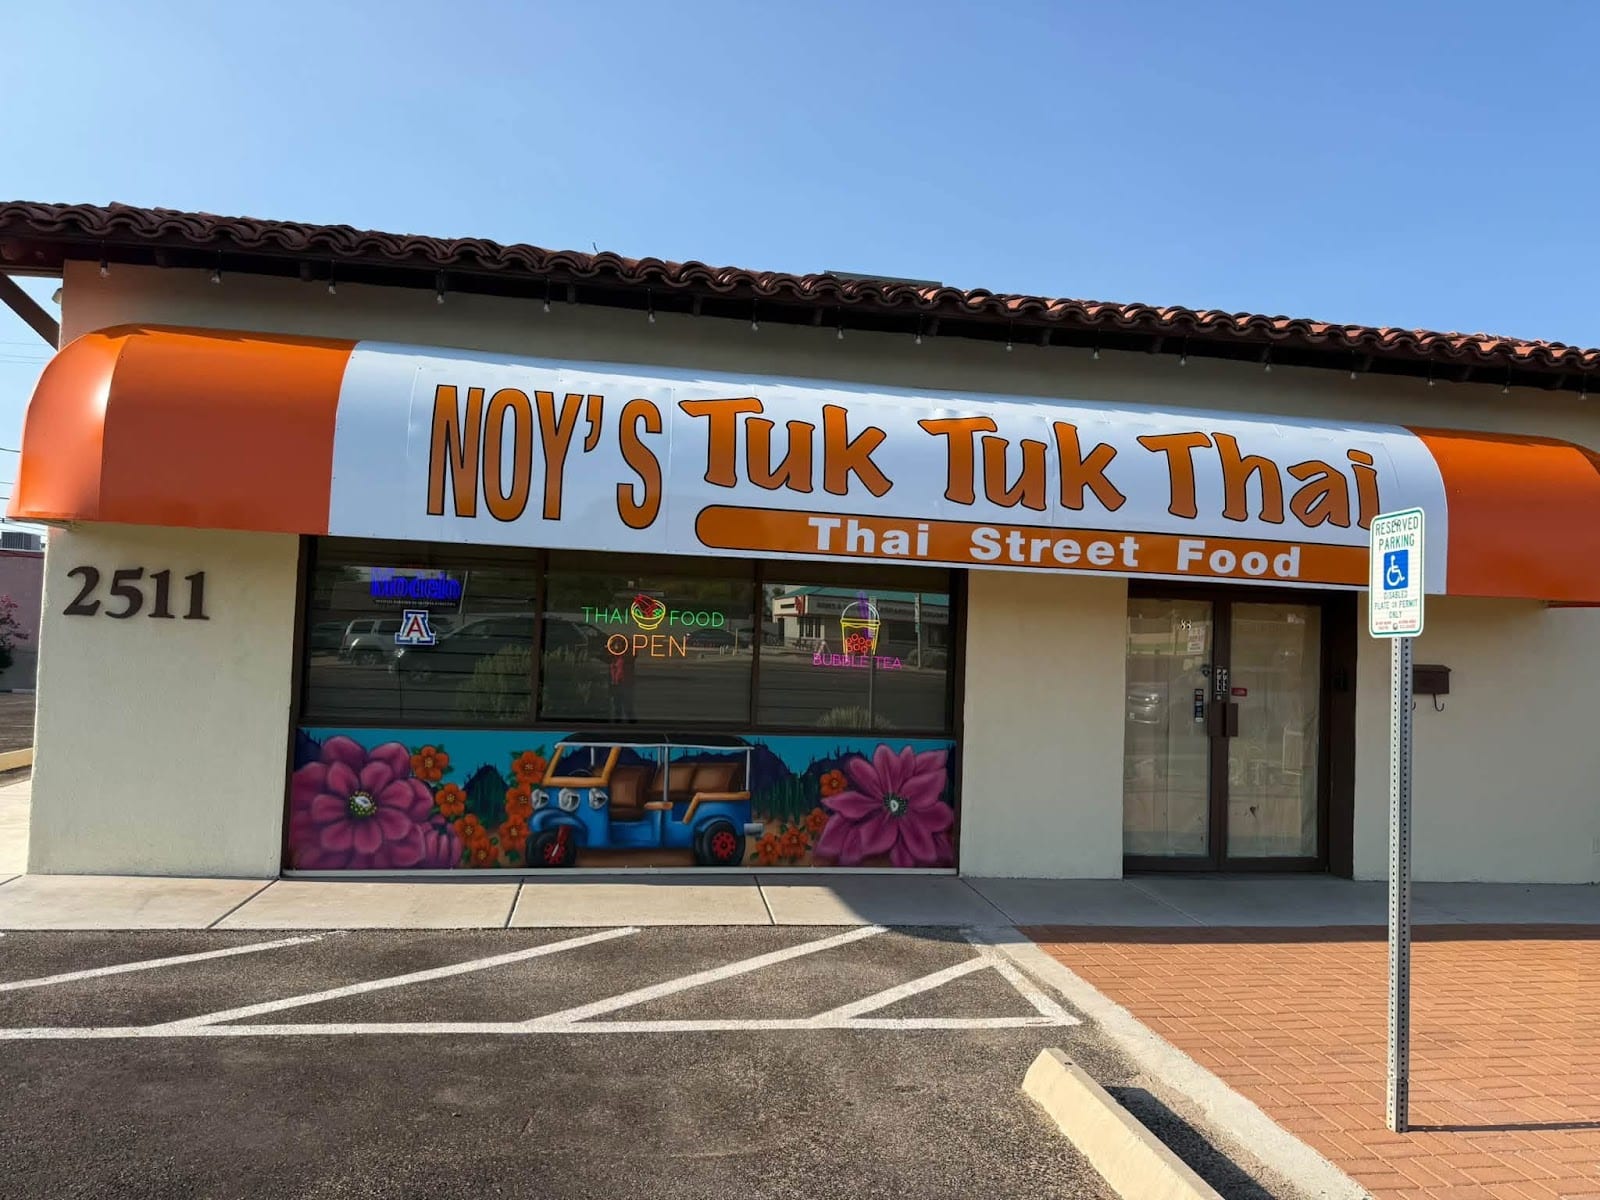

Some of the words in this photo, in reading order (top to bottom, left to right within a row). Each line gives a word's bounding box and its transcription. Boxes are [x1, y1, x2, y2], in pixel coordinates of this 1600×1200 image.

[427, 384, 662, 529] NOY'S
[678, 397, 893, 497] Tuk
[917, 416, 1126, 511] Tuk
[1136, 432, 1380, 530] Thai
[1375, 516, 1419, 536] RESERVED
[808, 517, 929, 556] Thai
[969, 526, 1139, 567] Street
[1176, 539, 1301, 578] Food
[1379, 533, 1415, 550] PARKING
[62, 566, 210, 620] 2511
[395, 609, 436, 645] A
[581, 606, 629, 624] THAI
[669, 610, 725, 627] FOOD
[606, 633, 688, 657] OPEN
[812, 653, 869, 668] BUBBLE
[874, 656, 903, 669] TEA
